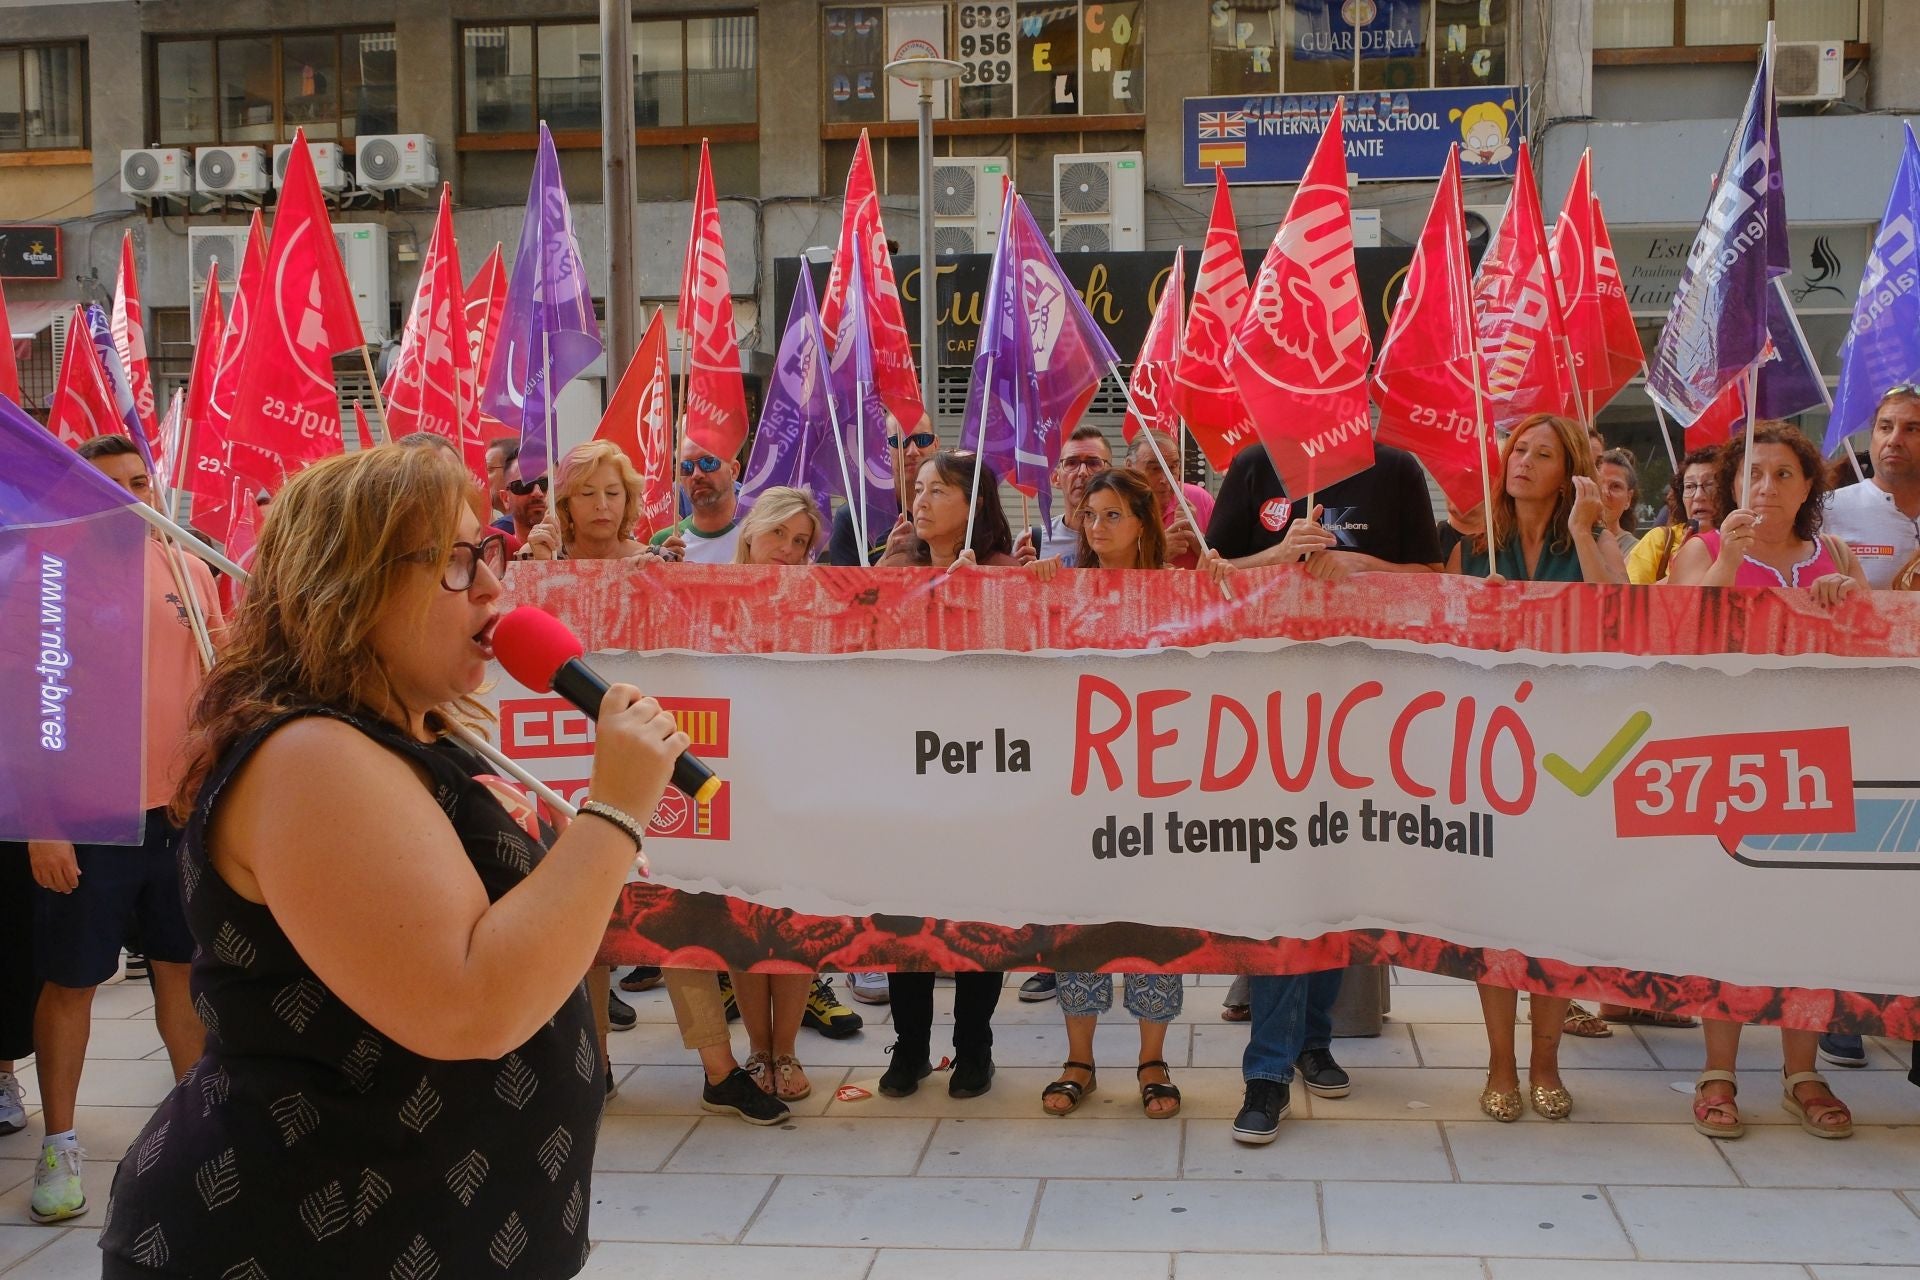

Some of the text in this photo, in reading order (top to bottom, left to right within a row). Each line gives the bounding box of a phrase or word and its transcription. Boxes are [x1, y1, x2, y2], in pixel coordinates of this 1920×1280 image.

[960, 6, 1012, 29] 639
[960, 32, 1012, 57] 956
[1301, 29, 1415, 51] GUARDERIA
[960, 60, 1012, 84] 369
[1258, 112, 1441, 136] INTERNANAL SCHOOL
[1343, 522, 1368, 531] Jeans
[1851, 546, 1879, 555] COO
[914, 674, 1538, 816] Per la REDUCCIÓ
[1633, 748, 1834, 825] 37,5 h
[1091, 799, 1494, 864] del temps de treball
